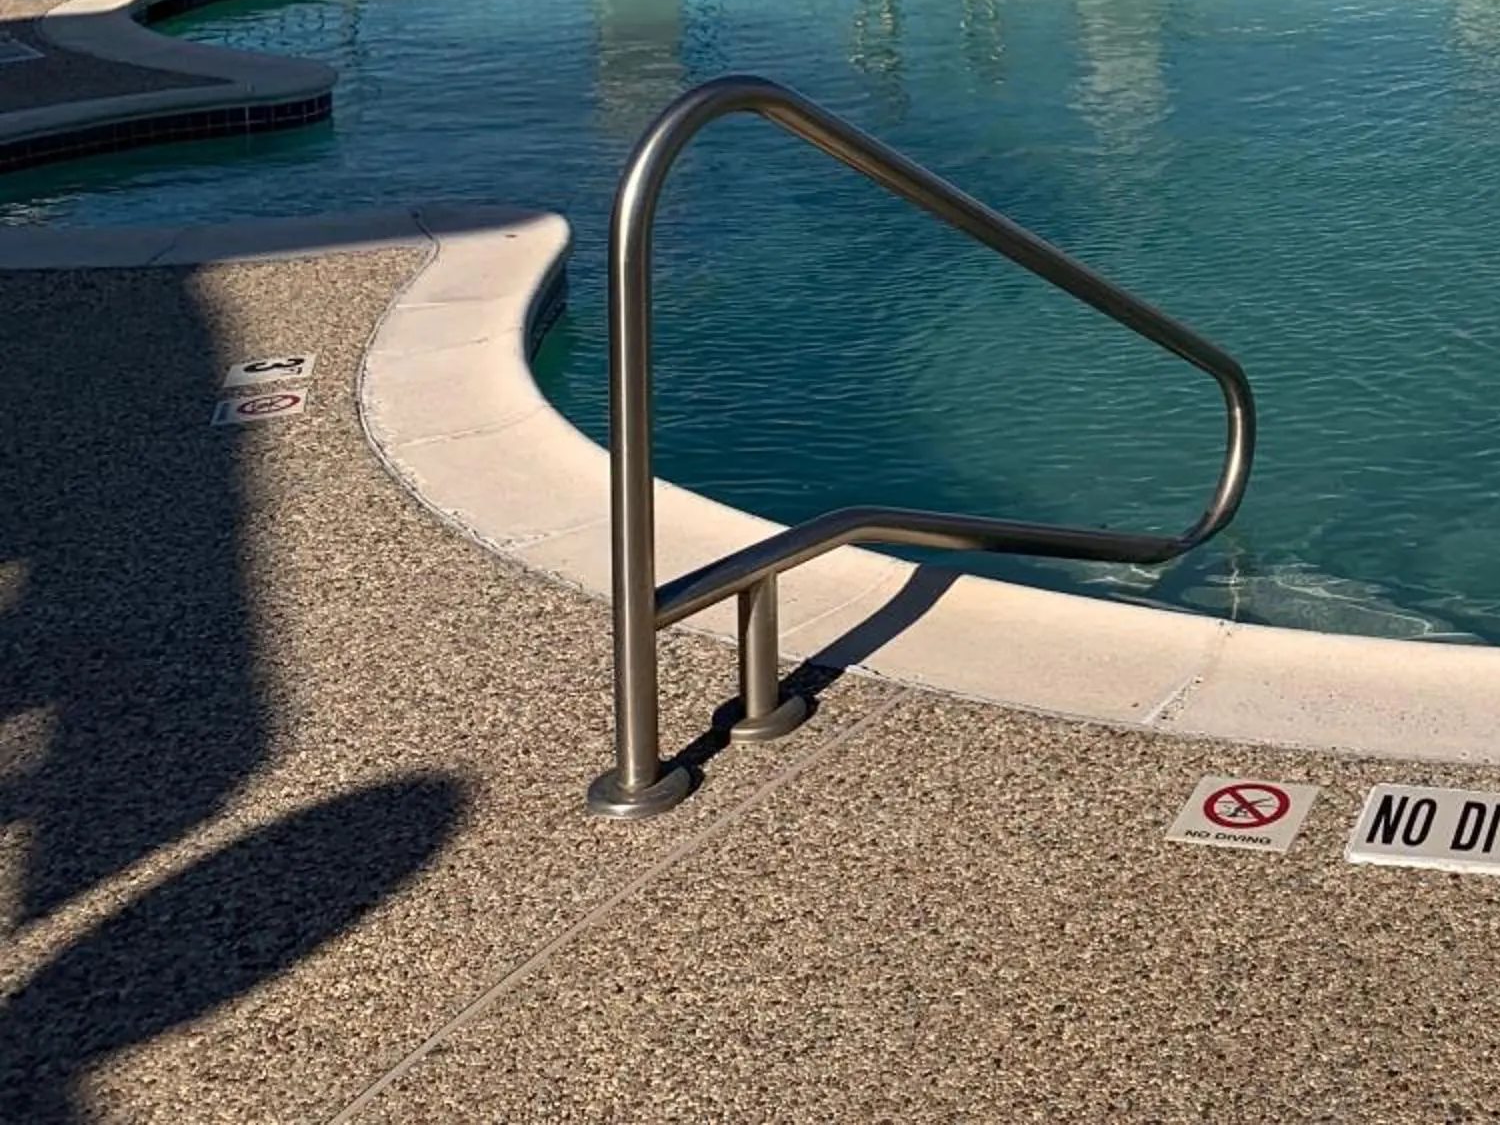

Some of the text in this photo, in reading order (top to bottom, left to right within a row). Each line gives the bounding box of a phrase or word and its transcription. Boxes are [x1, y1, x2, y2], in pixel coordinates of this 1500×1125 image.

[1184, 829, 1272, 845] NO DIVING
[1366, 794, 1437, 846] NO
